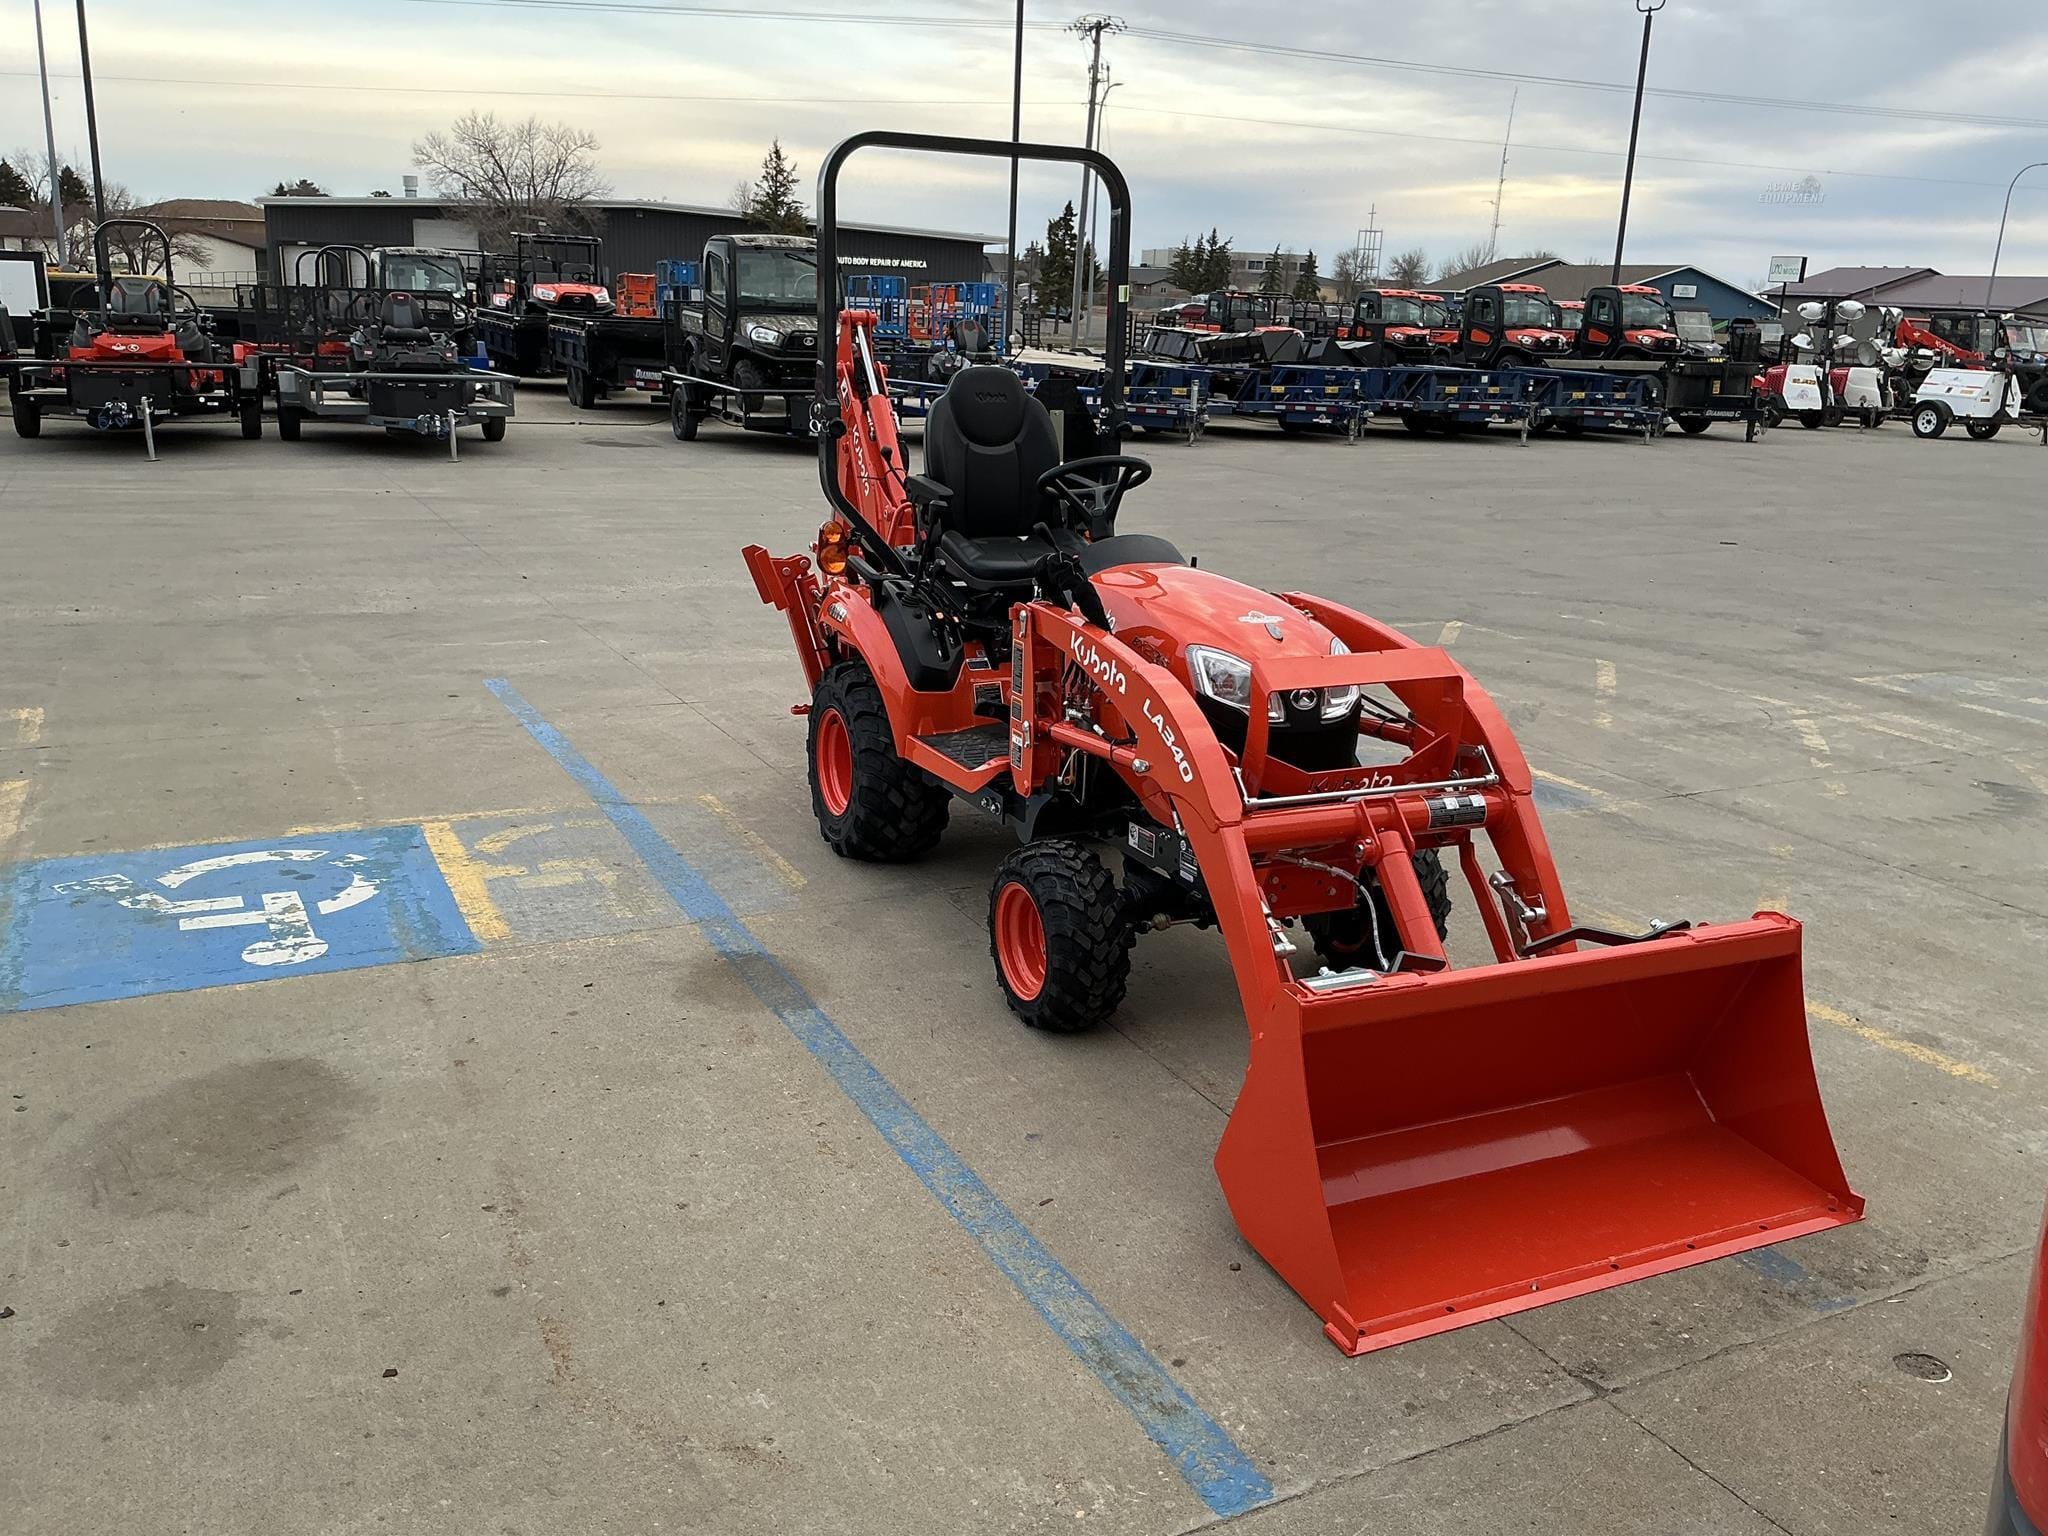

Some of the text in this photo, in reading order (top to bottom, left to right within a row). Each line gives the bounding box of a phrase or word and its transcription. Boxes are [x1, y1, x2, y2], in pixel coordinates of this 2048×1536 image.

[853, 257, 869, 266] BODY
[870, 258, 891, 267] REPAIR
[892, 259, 900, 267] OF
[900, 260, 927, 269] AMERICA
[853, 423, 869, 497] Kubota
[1070, 630, 1126, 695] Kubota
[1142, 697, 1194, 783] LA340
